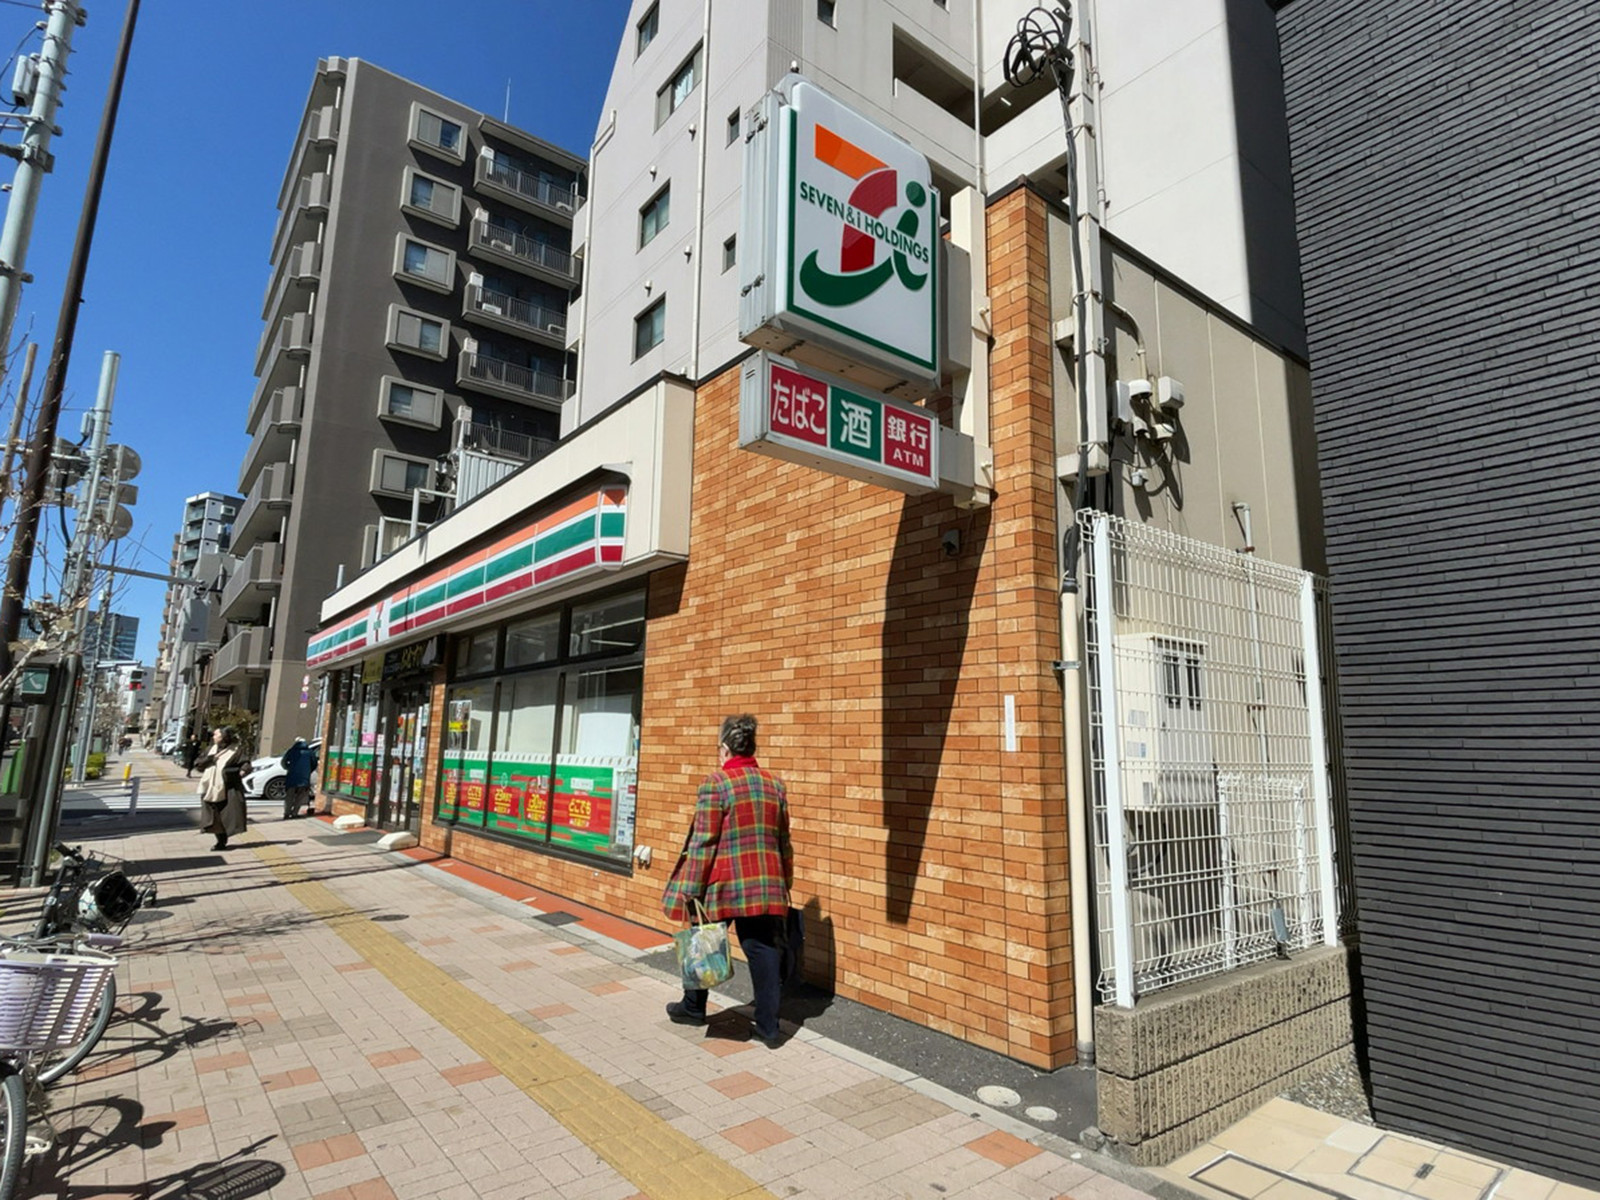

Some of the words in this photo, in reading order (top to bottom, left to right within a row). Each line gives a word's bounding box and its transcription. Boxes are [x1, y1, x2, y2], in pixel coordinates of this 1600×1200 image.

[865, 217, 930, 264] HOLDINGS
[772, 378, 826, 435] たばこ
[840, 399, 873, 449] 酒
[887, 415, 929, 450] 銀行
[893, 447, 925, 468] ATM
